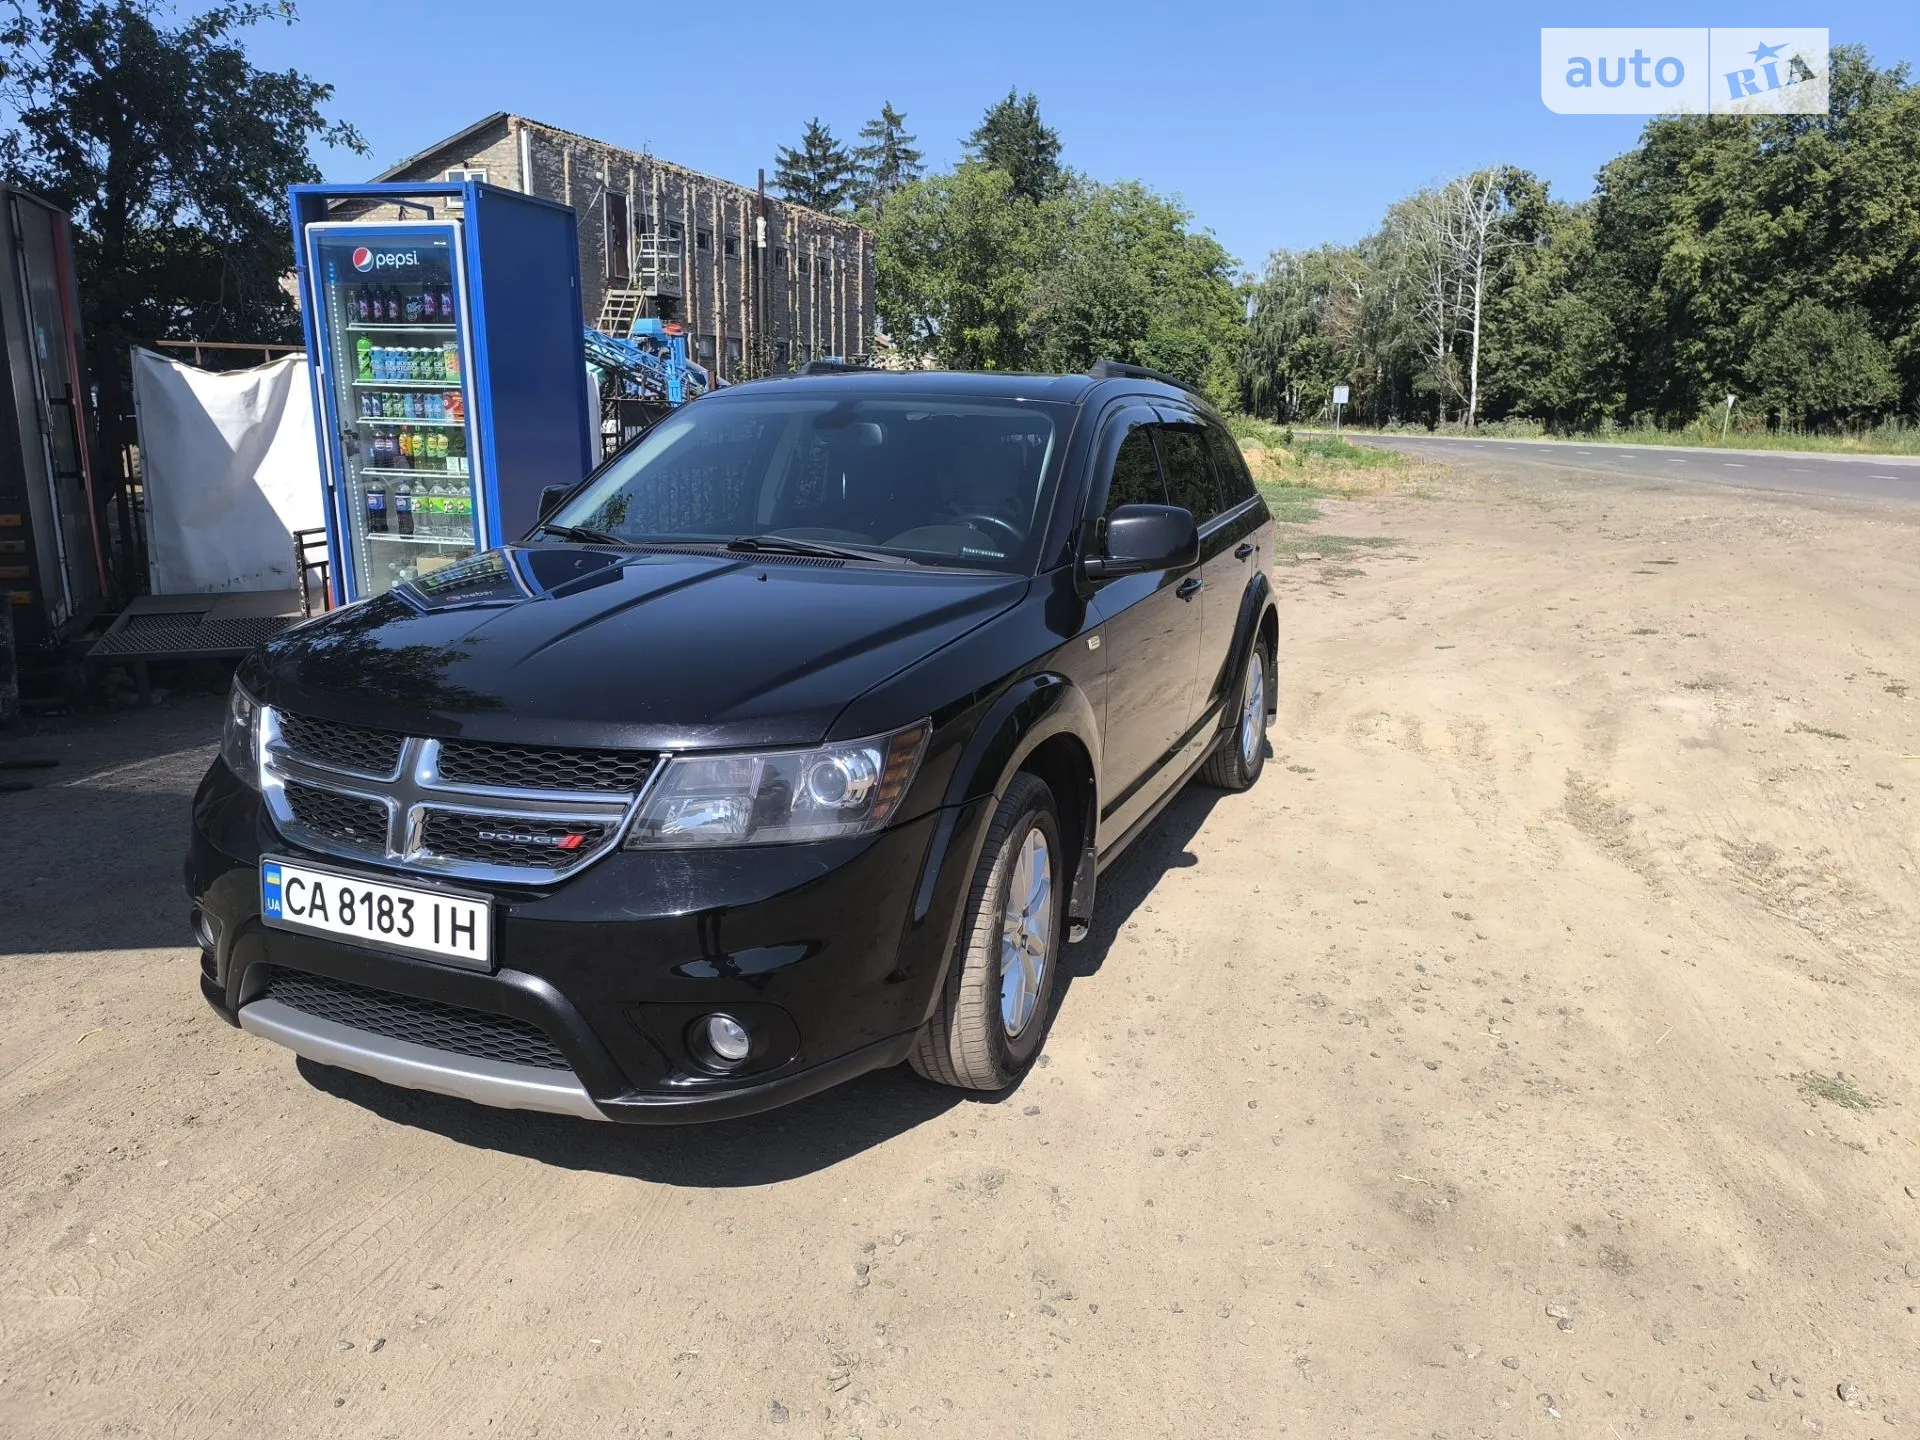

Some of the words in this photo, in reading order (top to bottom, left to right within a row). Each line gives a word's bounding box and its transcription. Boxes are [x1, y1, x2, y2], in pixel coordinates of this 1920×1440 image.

[375, 250, 419, 269] pepsi
[479, 831, 566, 845] DODGE
[267, 898, 280, 913] UA
[285, 877, 329, 922] CA
[338, 887, 415, 938] 8183
[433, 903, 475, 951] IH
